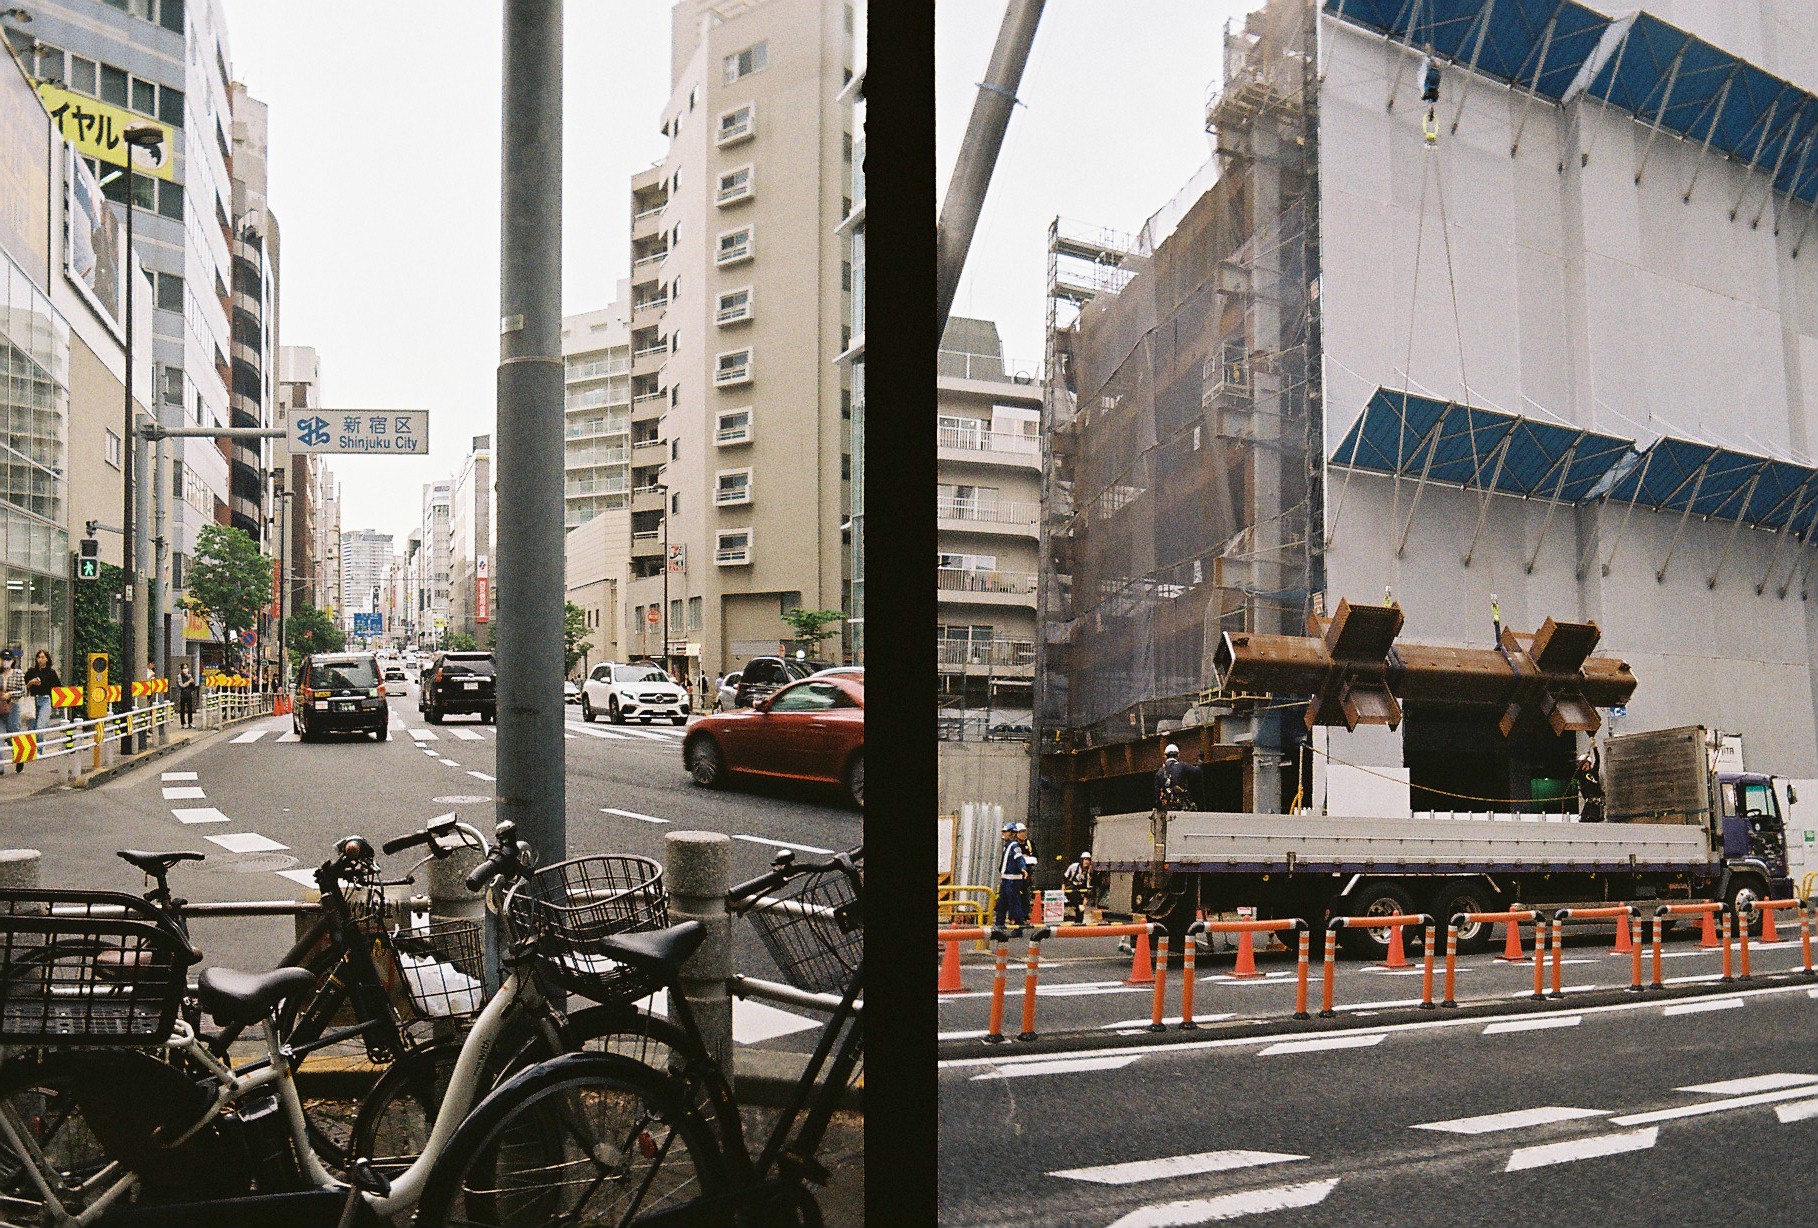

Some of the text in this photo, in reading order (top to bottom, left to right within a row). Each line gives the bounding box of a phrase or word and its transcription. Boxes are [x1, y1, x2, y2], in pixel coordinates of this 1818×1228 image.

[51, 102, 119, 150] イヤル
[343, 415, 412, 434] 新宿区
[339, 435, 418, 451] Shinjuku City
